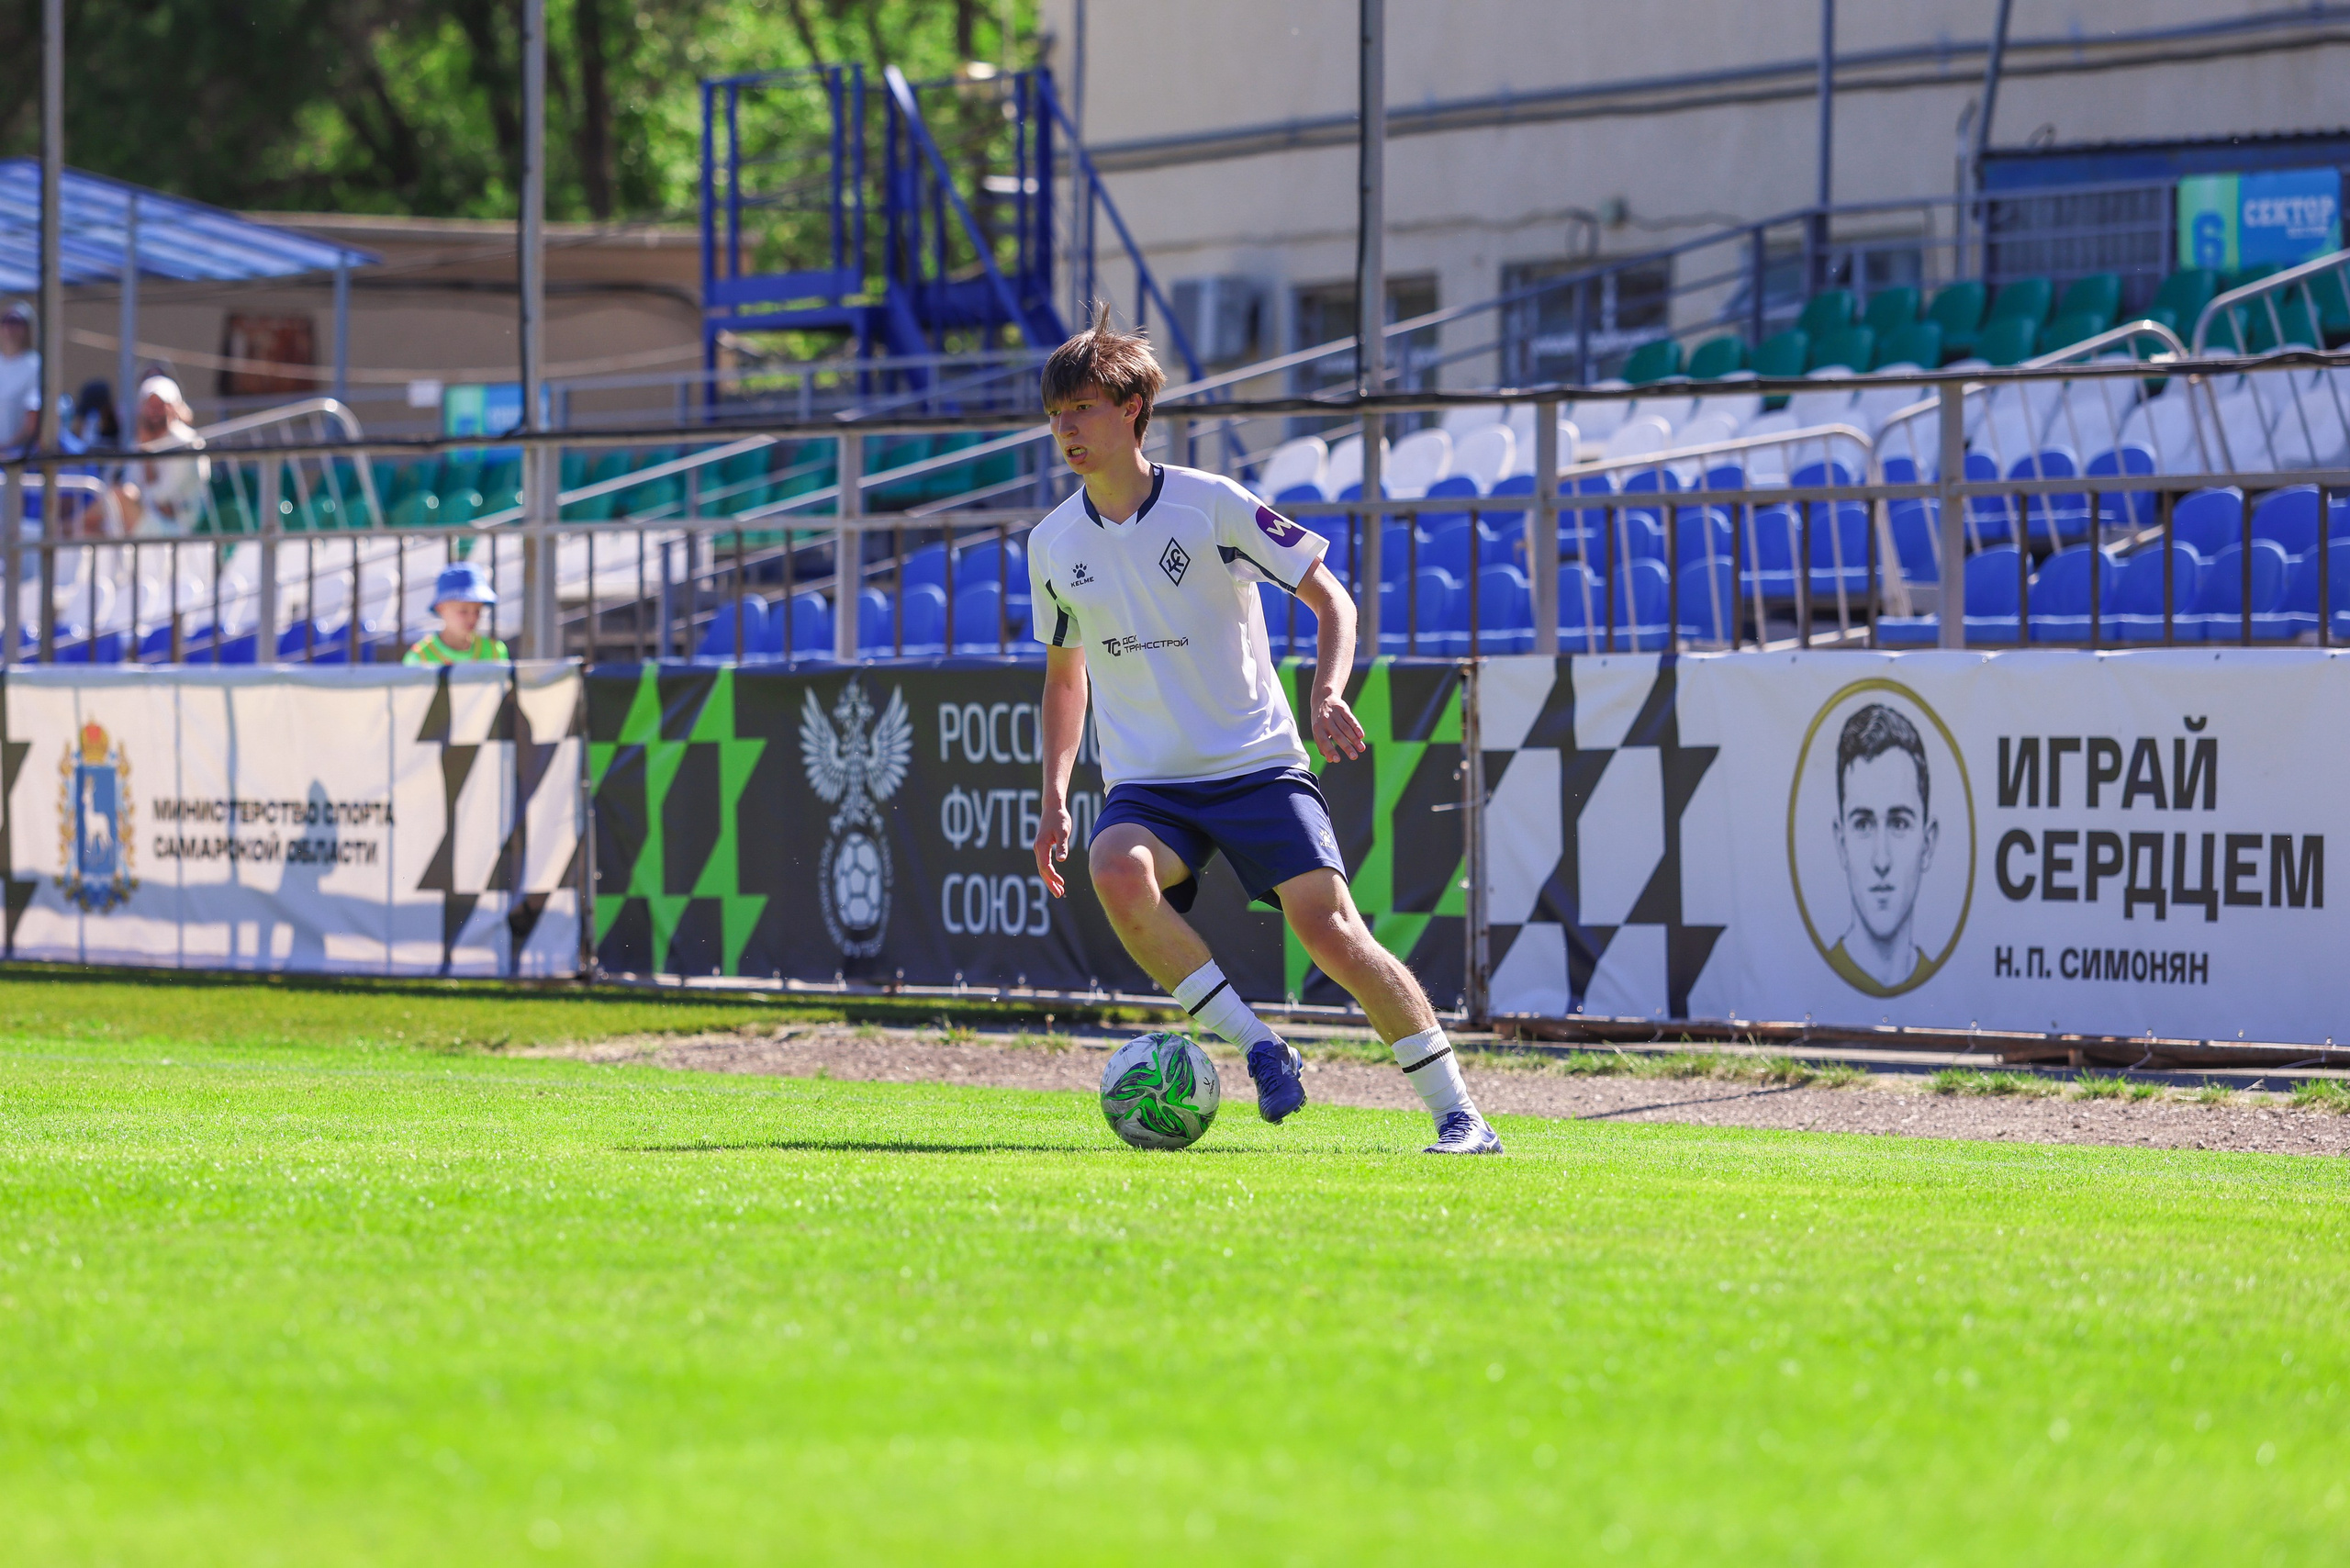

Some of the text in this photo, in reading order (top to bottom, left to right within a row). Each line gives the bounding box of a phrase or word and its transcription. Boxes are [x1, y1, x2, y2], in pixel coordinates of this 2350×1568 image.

[2192, 211, 2225, 270] 6
[1070, 577, 1094, 588] KELME
[1124, 637, 1189, 654] ТРАНССТРОЙ
[1998, 716, 2218, 812] ИГРАЙ
[152, 797, 395, 826] МИНИСТЕРСТВО СПОРТА
[153, 831, 377, 864] САМАРСКОЙ ОБЛАСТИ
[1996, 829, 2324, 923] СЕРДЦЕМ
[942, 873, 1052, 936] СОЮЗ
[1995, 946, 2210, 986] Н. П. СИМОНЯН
